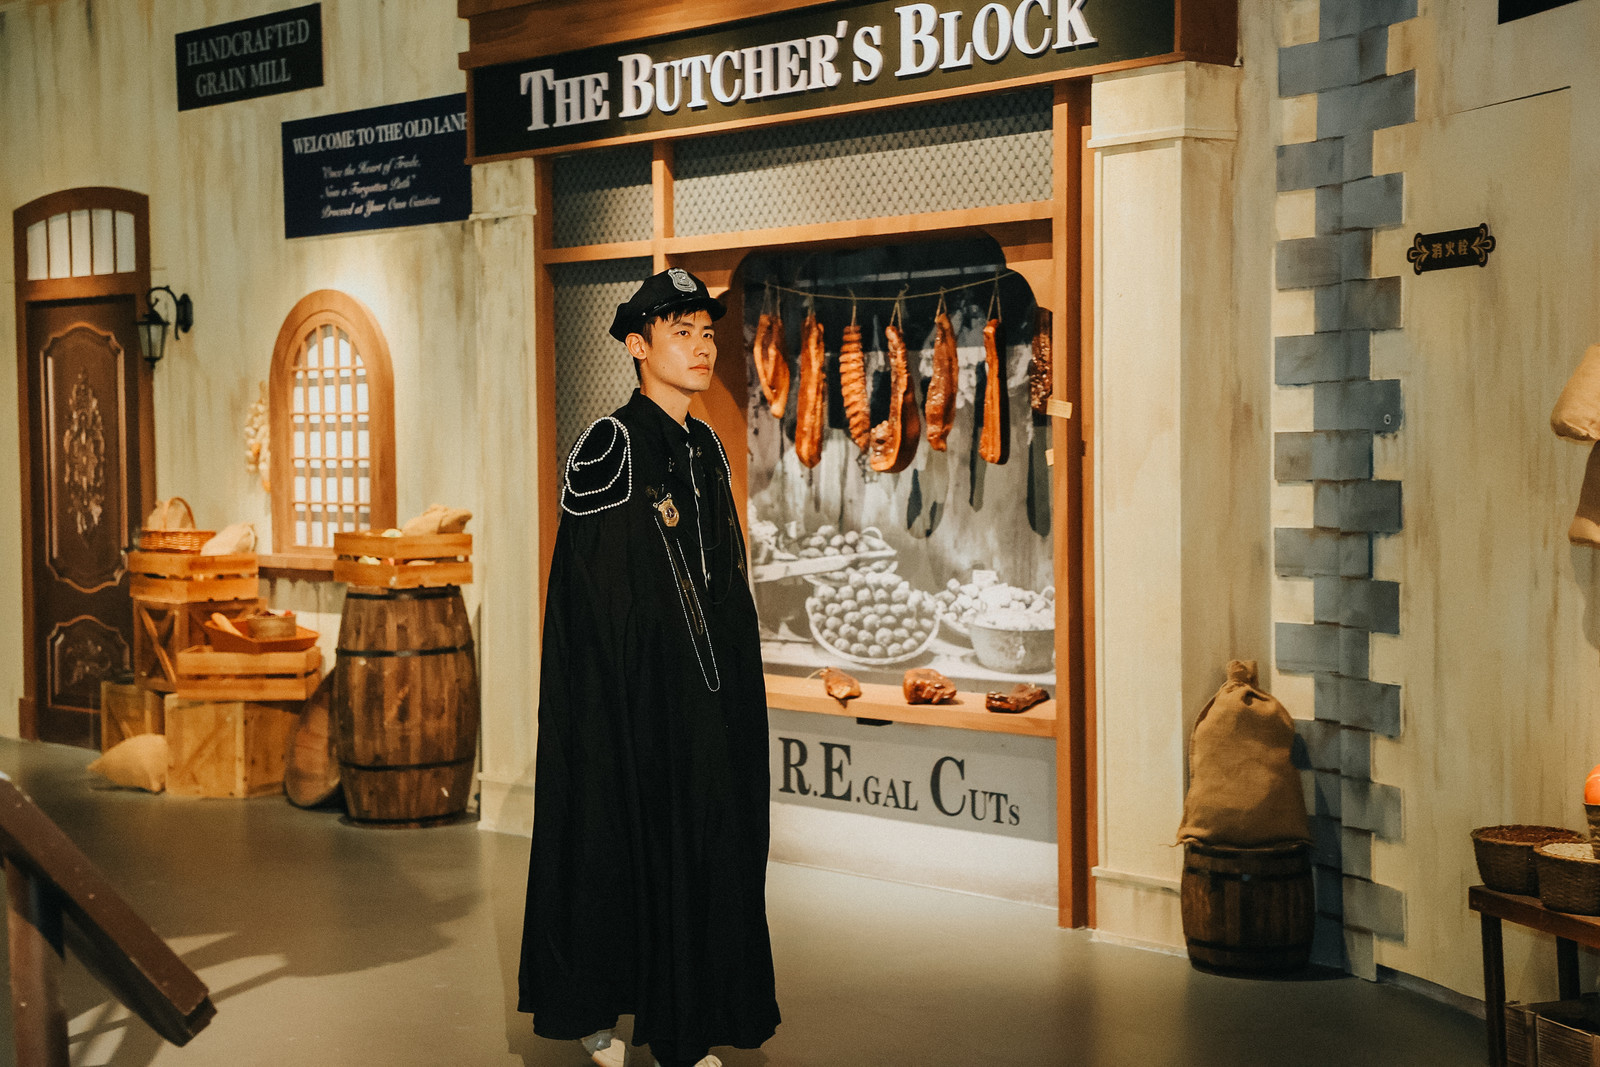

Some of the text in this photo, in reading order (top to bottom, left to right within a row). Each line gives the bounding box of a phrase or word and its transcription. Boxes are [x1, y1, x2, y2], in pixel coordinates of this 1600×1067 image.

[186, 18, 310, 67] HANDCRAFTED
[195, 58, 291, 98] GRAIN MILL
[520, 0, 1098, 132] THE BUTCHER'S BLOCK
[292, 130, 355, 155] WELCOME
[356, 126, 375, 146] TO
[376, 122, 403, 143] THE
[404, 117, 432, 139] OLD
[382, 157, 395, 176] of
[341, 188, 347, 196] a
[354, 204, 364, 215] at
[1431, 238, 1469, 259] 消火栓
